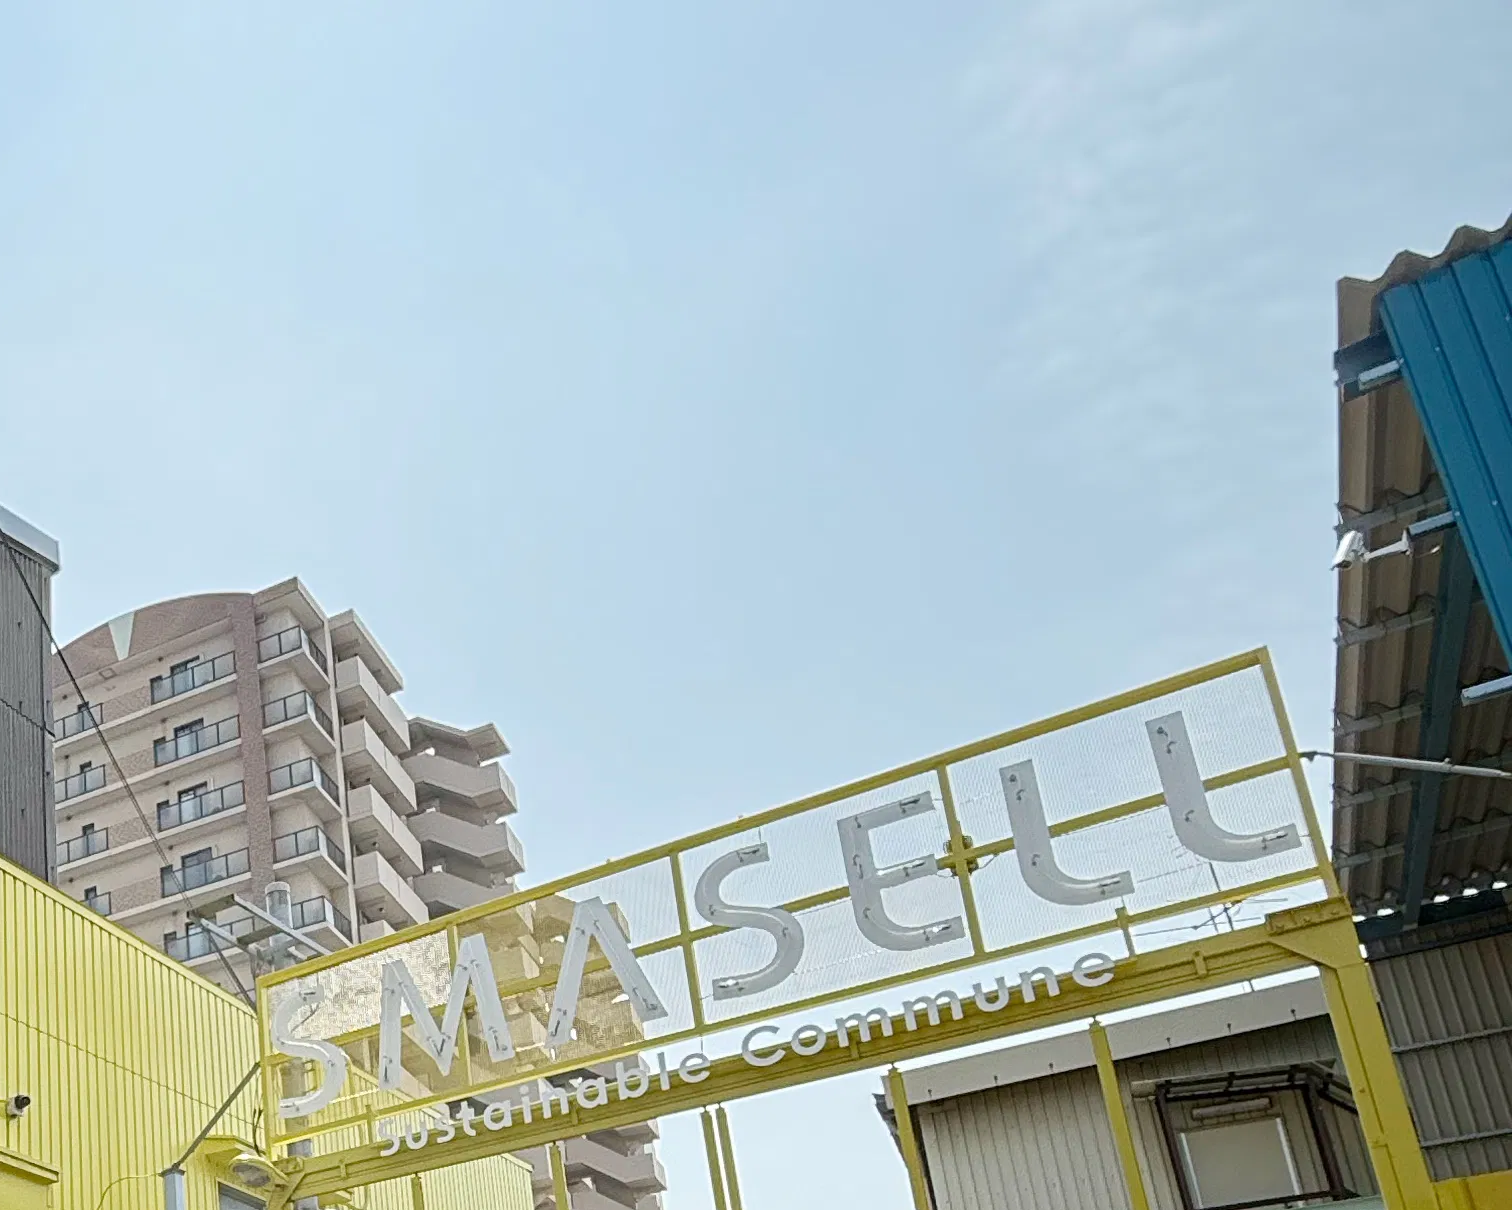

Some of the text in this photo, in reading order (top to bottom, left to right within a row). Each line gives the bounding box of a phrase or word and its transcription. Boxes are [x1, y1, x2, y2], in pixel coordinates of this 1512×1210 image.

[271, 711, 1302, 1119] SMASELL
[378, 952, 1116, 1157] Sustainable Commune
